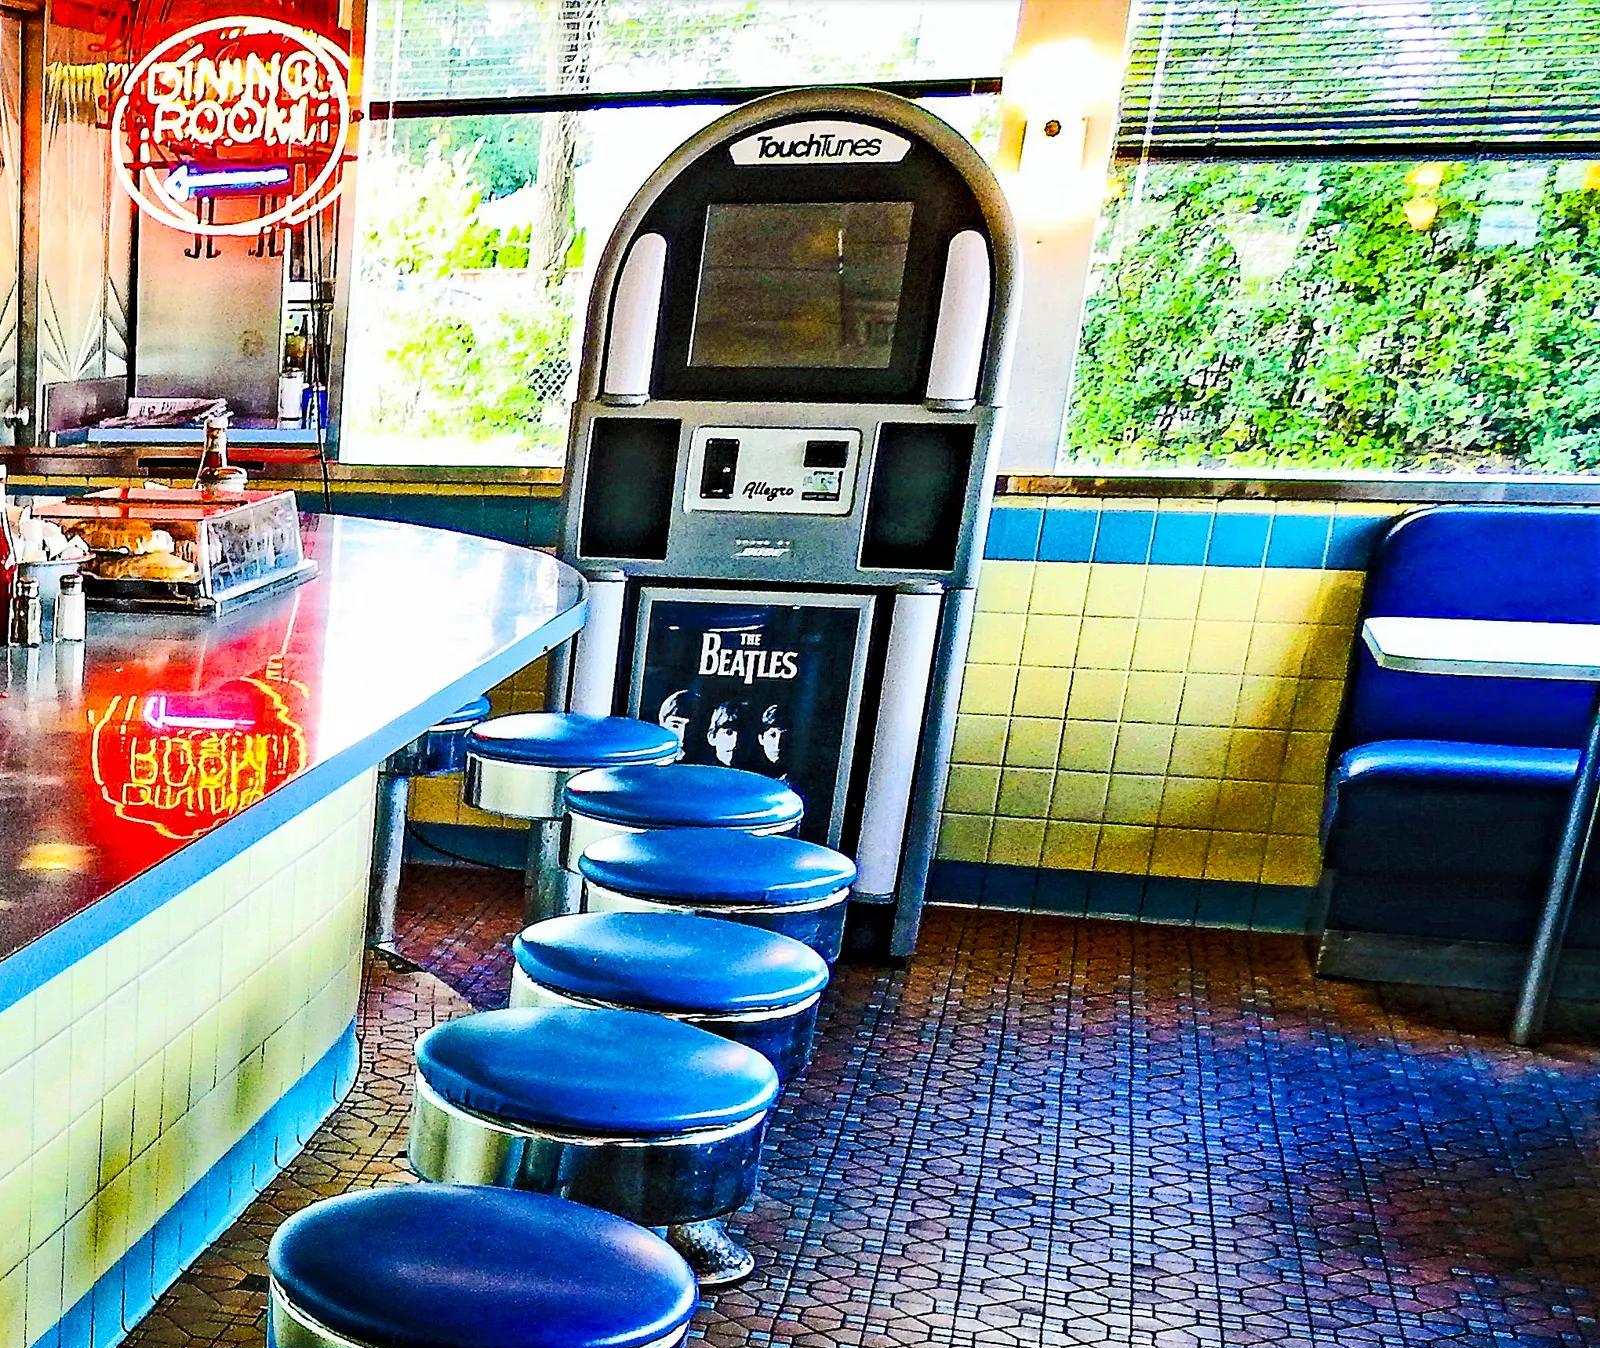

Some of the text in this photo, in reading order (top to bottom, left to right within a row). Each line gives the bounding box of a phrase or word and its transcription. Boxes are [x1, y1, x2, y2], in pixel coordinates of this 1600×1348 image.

[147, 50, 319, 104] DINING
[153, 98, 311, 146] ROOM
[757, 133, 882, 159] TouchTunes
[742, 482, 794, 501] Allegro
[699, 632, 798, 684] BEATLES
[740, 633, 762, 646] THE
